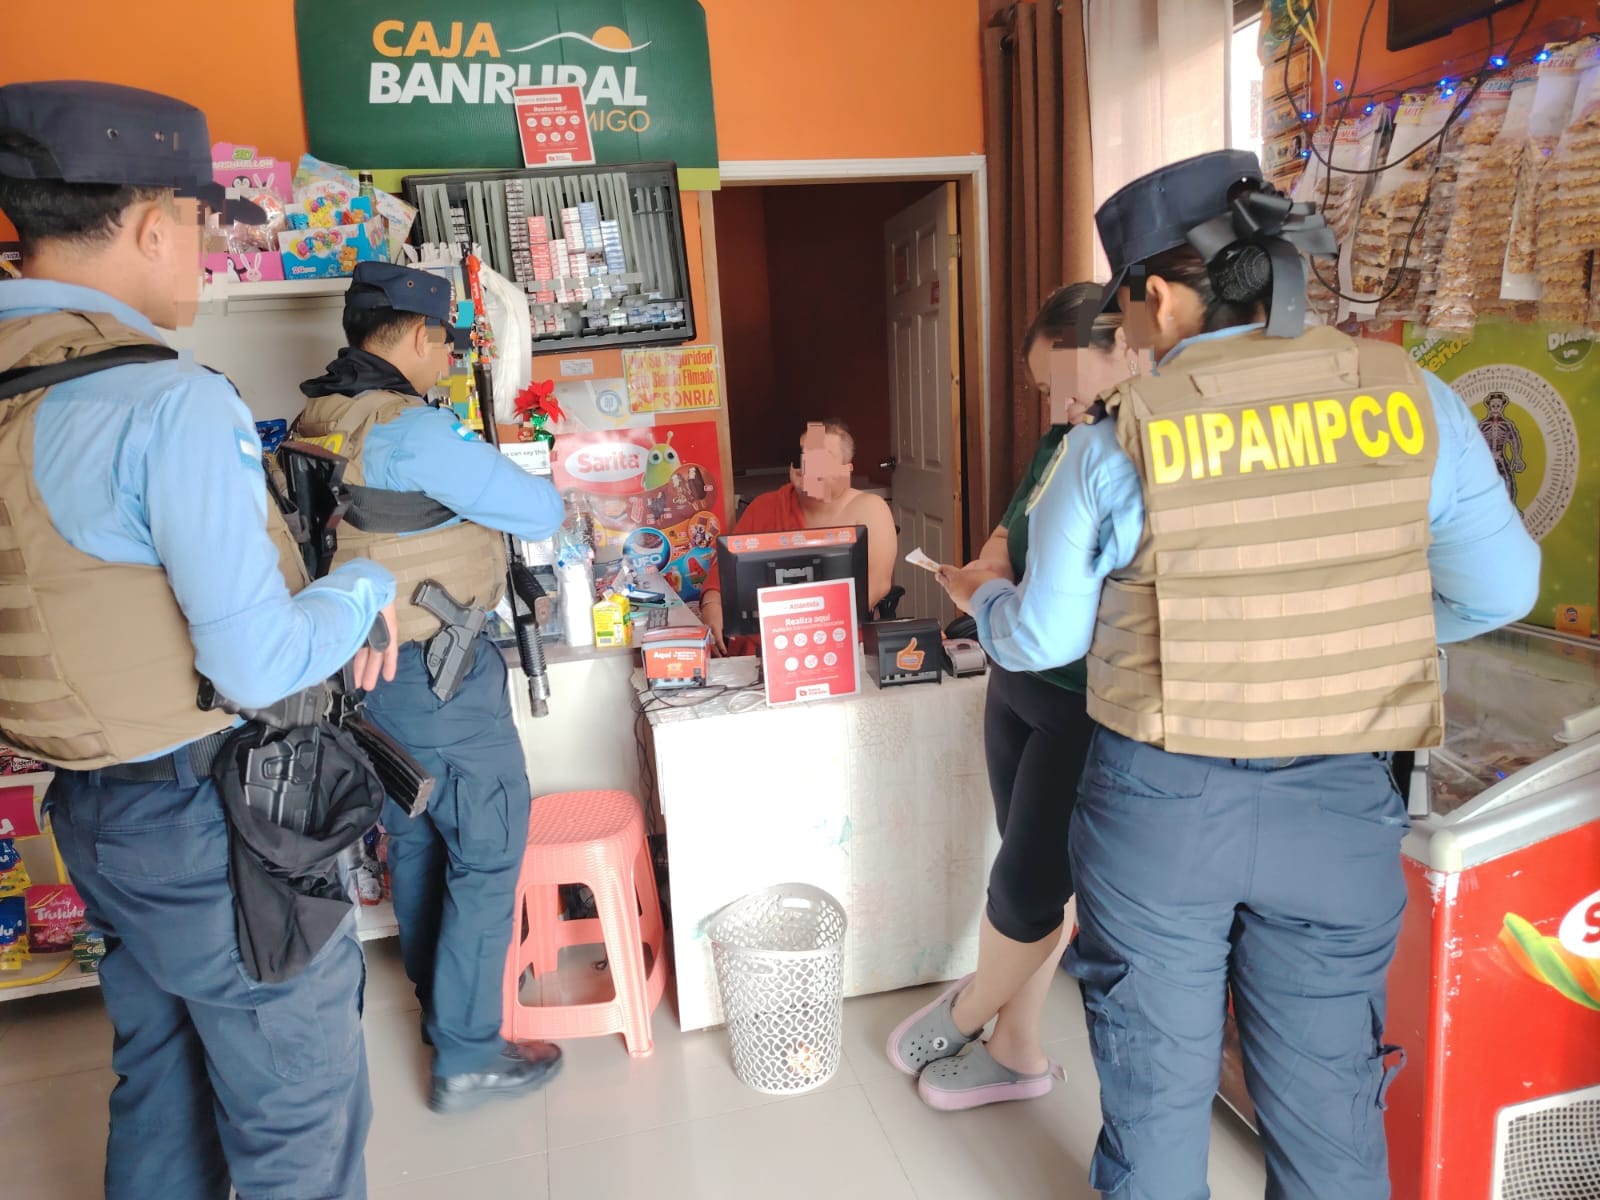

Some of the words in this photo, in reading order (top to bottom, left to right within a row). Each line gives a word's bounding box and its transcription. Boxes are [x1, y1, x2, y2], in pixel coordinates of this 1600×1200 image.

[372, 20, 500, 58] CAJA
[587, 110, 650, 133] MIGO
[682, 368, 714, 386] Filmado
[1147, 391, 1425, 484] DIPAMPCO
[577, 452, 640, 474] Sarita
[785, 616, 813, 626] Realiza
